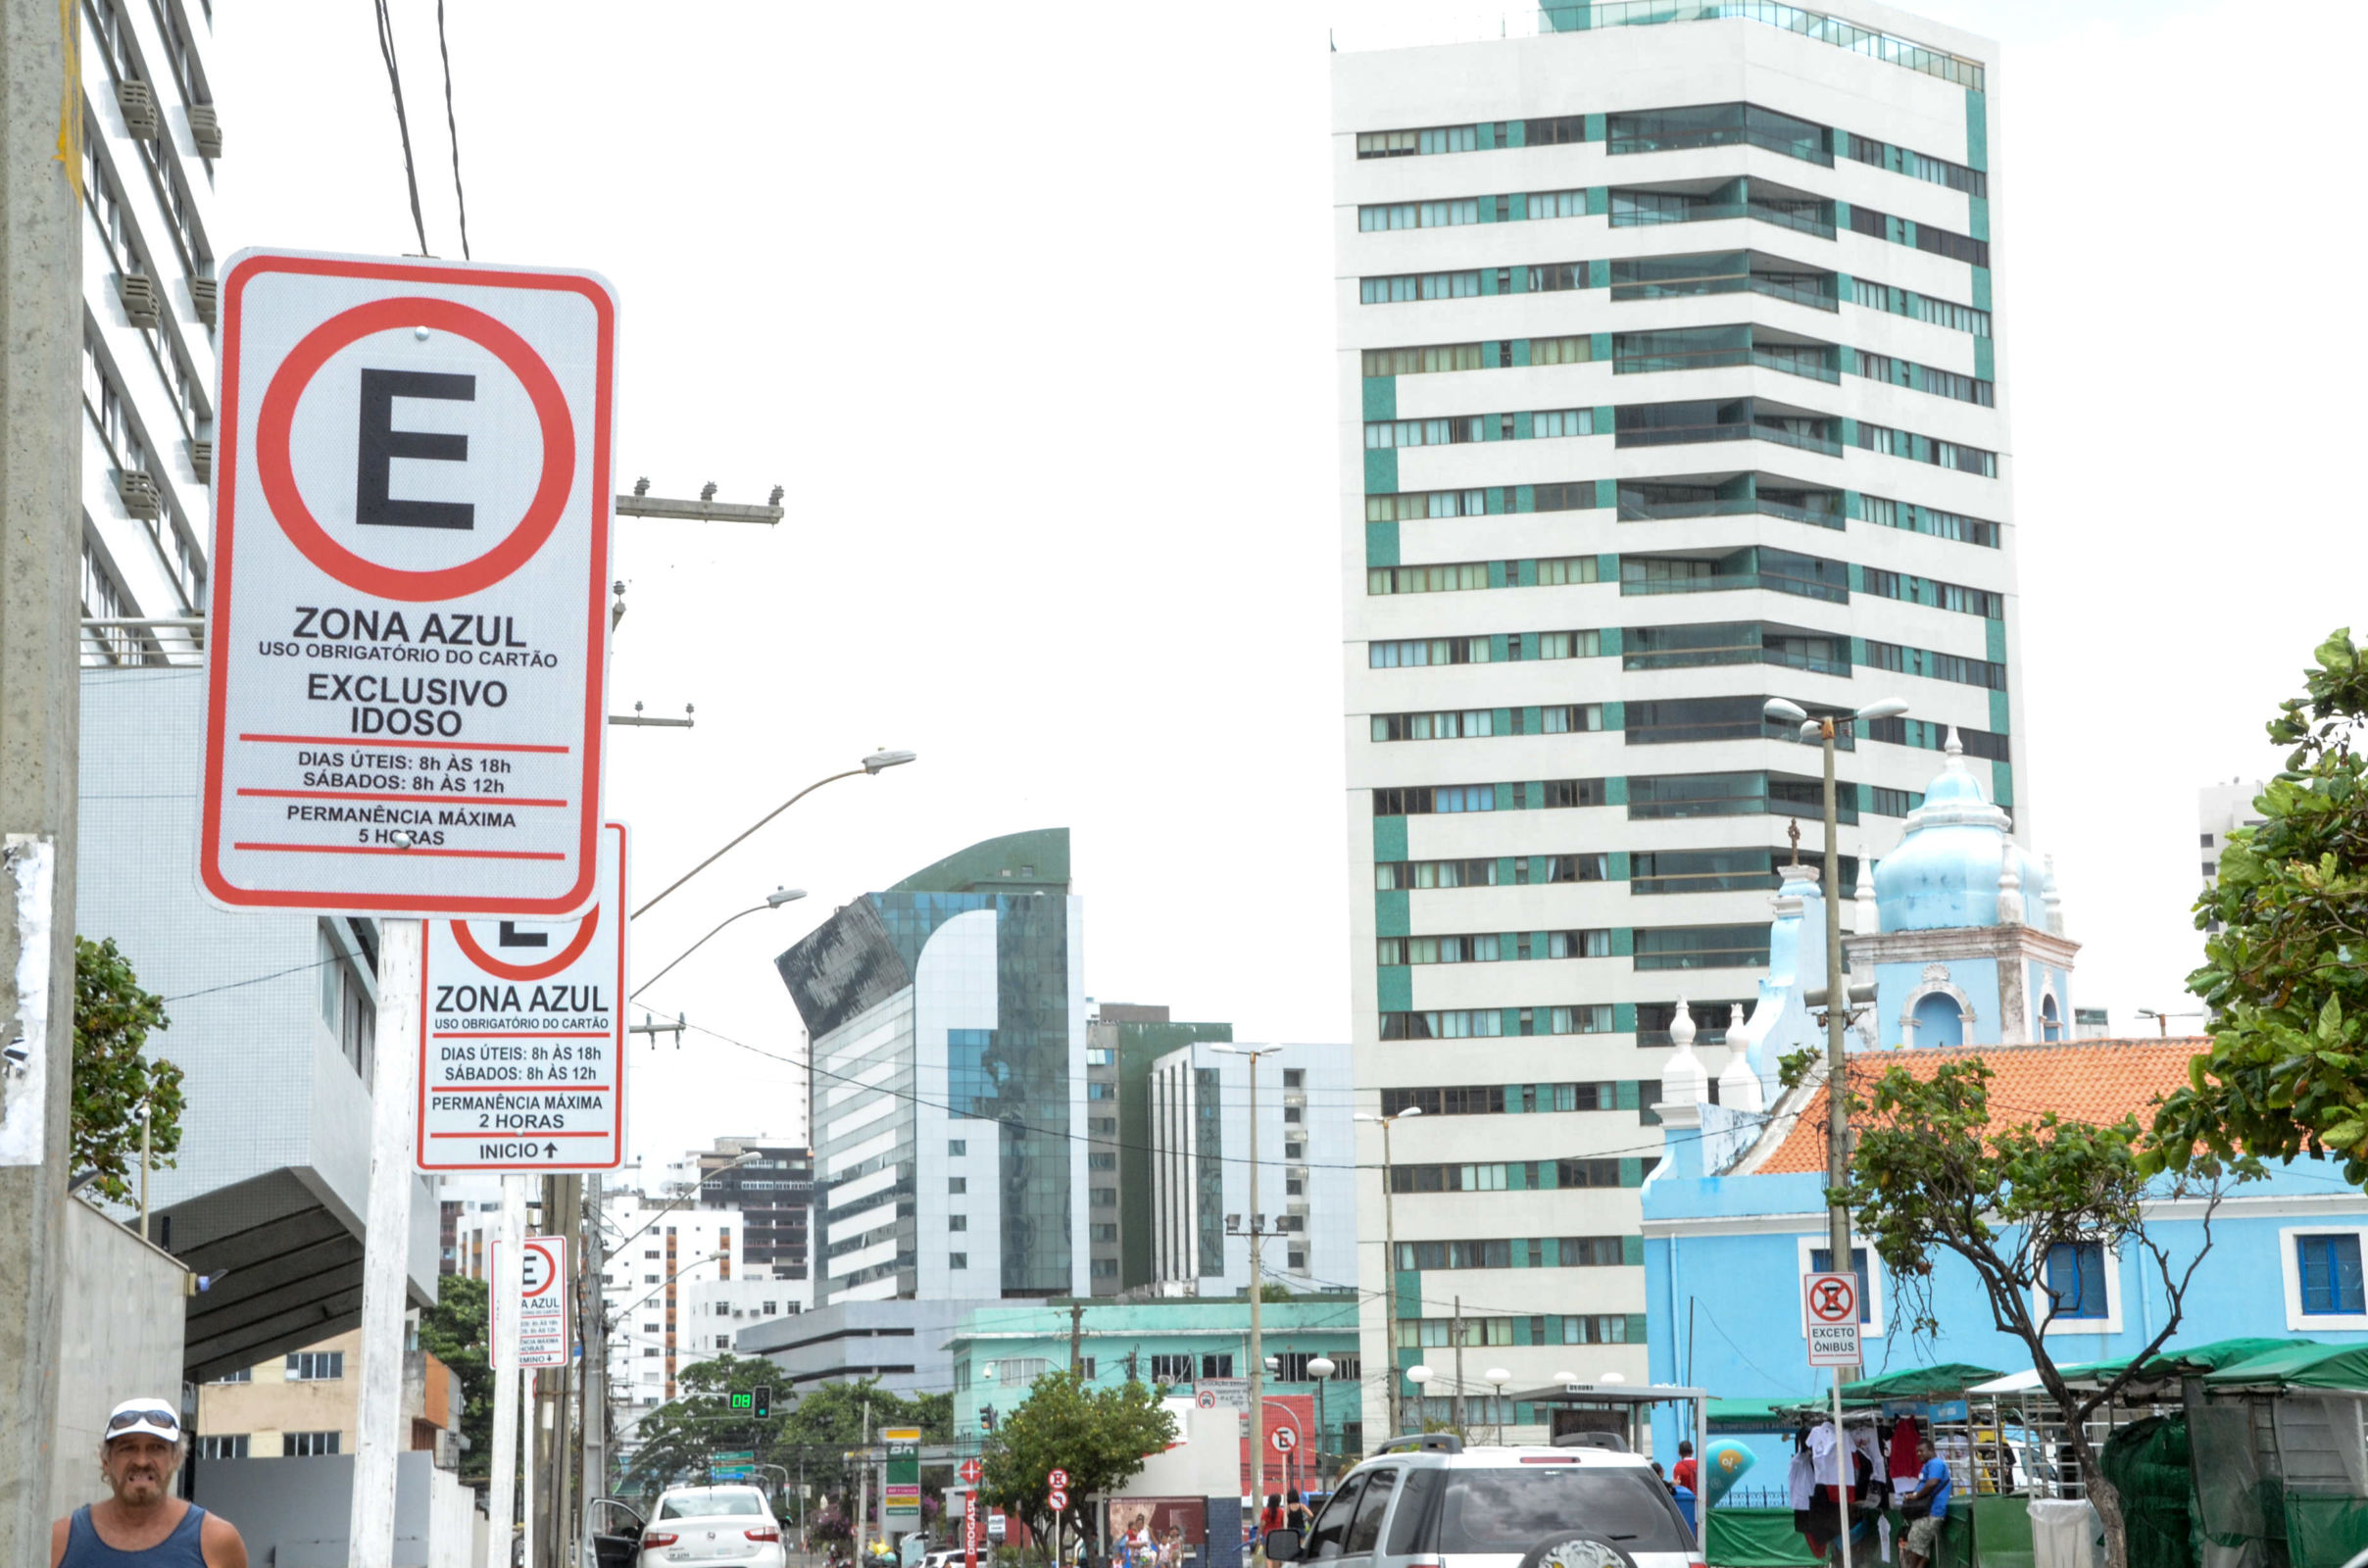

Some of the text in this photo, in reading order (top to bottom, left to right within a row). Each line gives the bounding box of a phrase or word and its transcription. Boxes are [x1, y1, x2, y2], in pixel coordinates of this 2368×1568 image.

[357, 368, 476, 529] E
[293, 608, 526, 648] ZONA AZUL
[259, 642, 558, 668] USO OBRIGATÓRIO DO CARTÃO
[308, 673, 508, 709] EXCLUSIVO
[351, 706, 463, 738] IDOSO
[298, 748, 511, 774] DIAS ÚTEIS: 8h ÀS 18h
[303, 767, 505, 795] SÁBADOS: 8h ÀS 12h
[287, 803, 517, 828] PERMANÊNCIA MÁXIMA
[359, 828, 445, 846] 5 HORAS
[435, 985, 609, 1012] ZONA AZUL
[434, 1016, 609, 1029] USO OBRIGATÓRIO DO CARTÃO
[441, 1043, 602, 1061] DIAS ÚTEIS: 8h ÀS 18h
[445, 1063, 597, 1081] SÁBADOS: 8h ÀS 12h
[432, 1094, 603, 1110] PERMANÊNCIA MÁXIMA
[479, 1113, 565, 1129] 2 HORAS
[479, 1143, 539, 1159] INICIO
[530, 1298, 560, 1308] AZUL
[1812, 1327, 1854, 1339] EXCETO
[1814, 1340, 1854, 1352] ÔNIBUS
[731, 1394, 752, 1408] 08
[966, 1496, 976, 1556] DROGASIL
